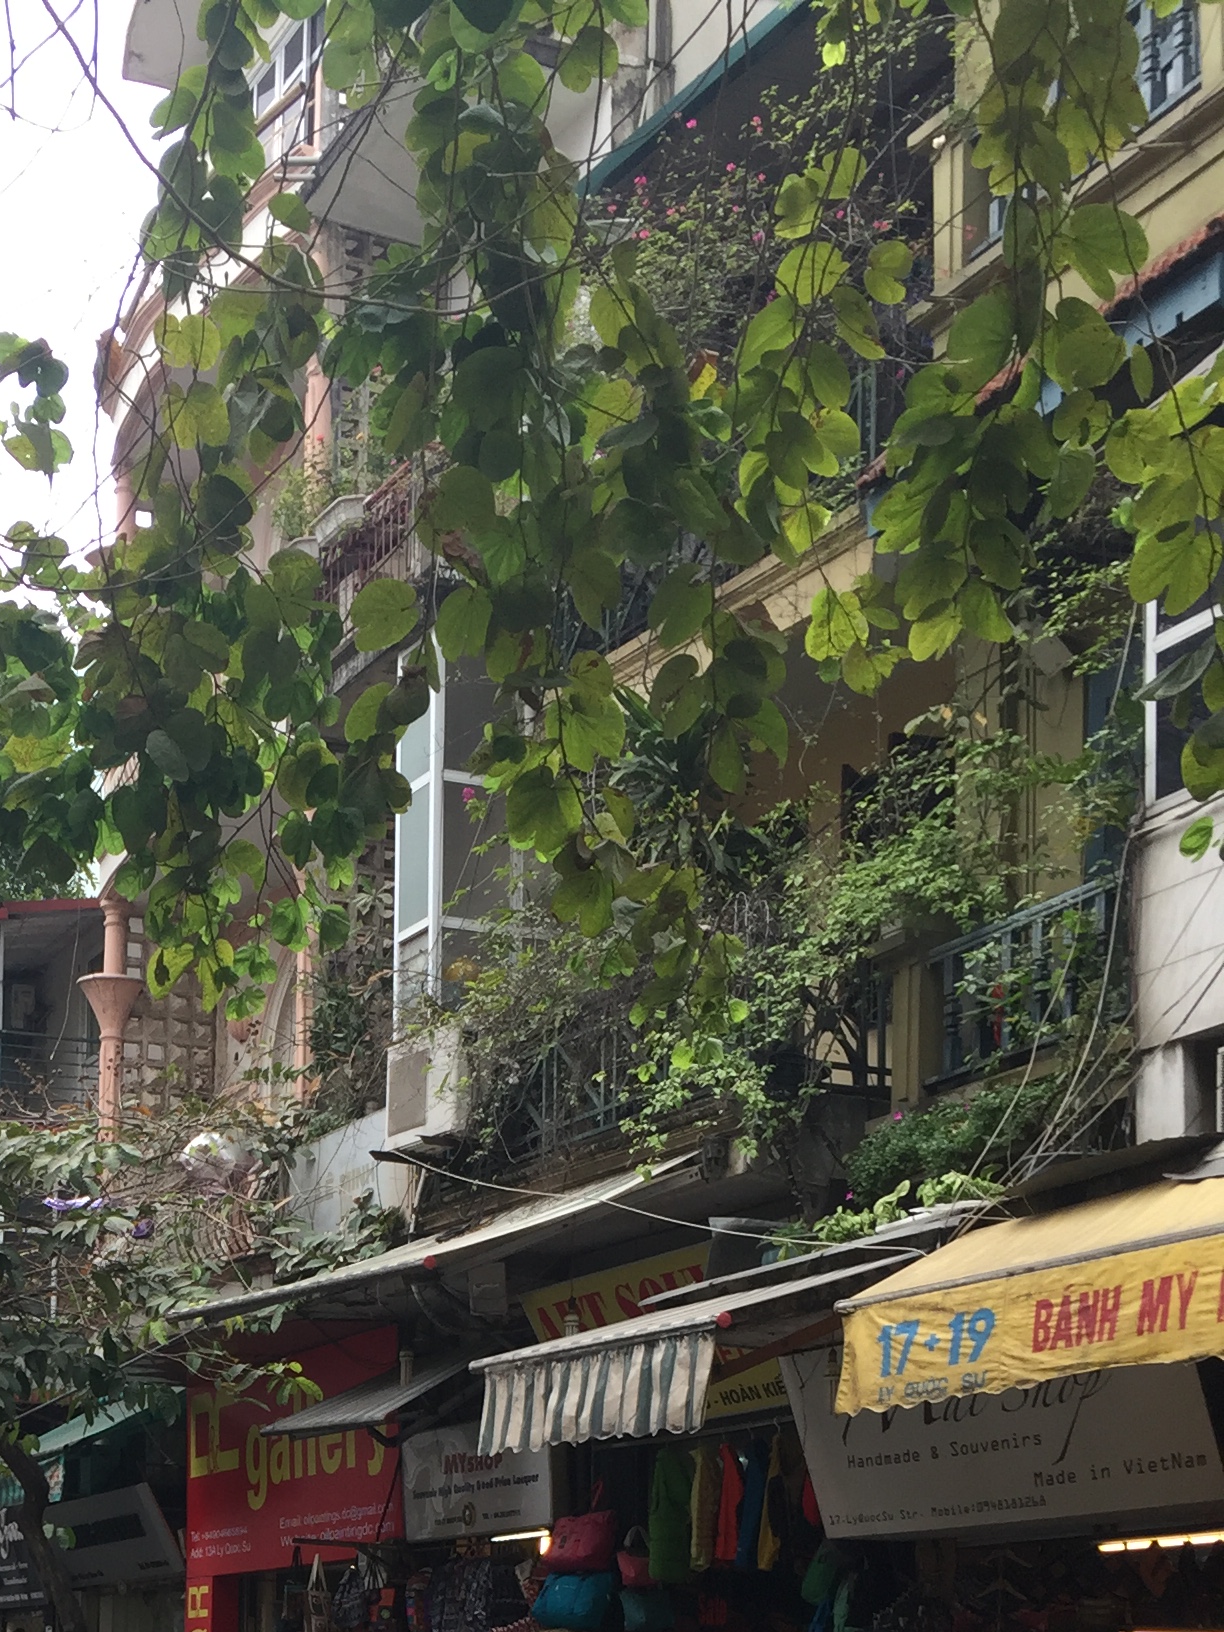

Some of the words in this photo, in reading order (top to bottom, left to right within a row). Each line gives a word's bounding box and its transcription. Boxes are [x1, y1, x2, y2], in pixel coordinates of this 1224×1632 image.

[719, 1383, 762, 1406] HOÀN
[762, 1373, 788, 1399] KIẾ
[847, 1448, 920, 1469] Handmade
[931, 1446, 940, 1459] &
[950, 1432, 1043, 1457] Souvenirs
[1034, 1471, 1077, 1489] Made
[1091, 1465, 1111, 1480] in
[1123, 1452, 1208, 1476] VietNam
